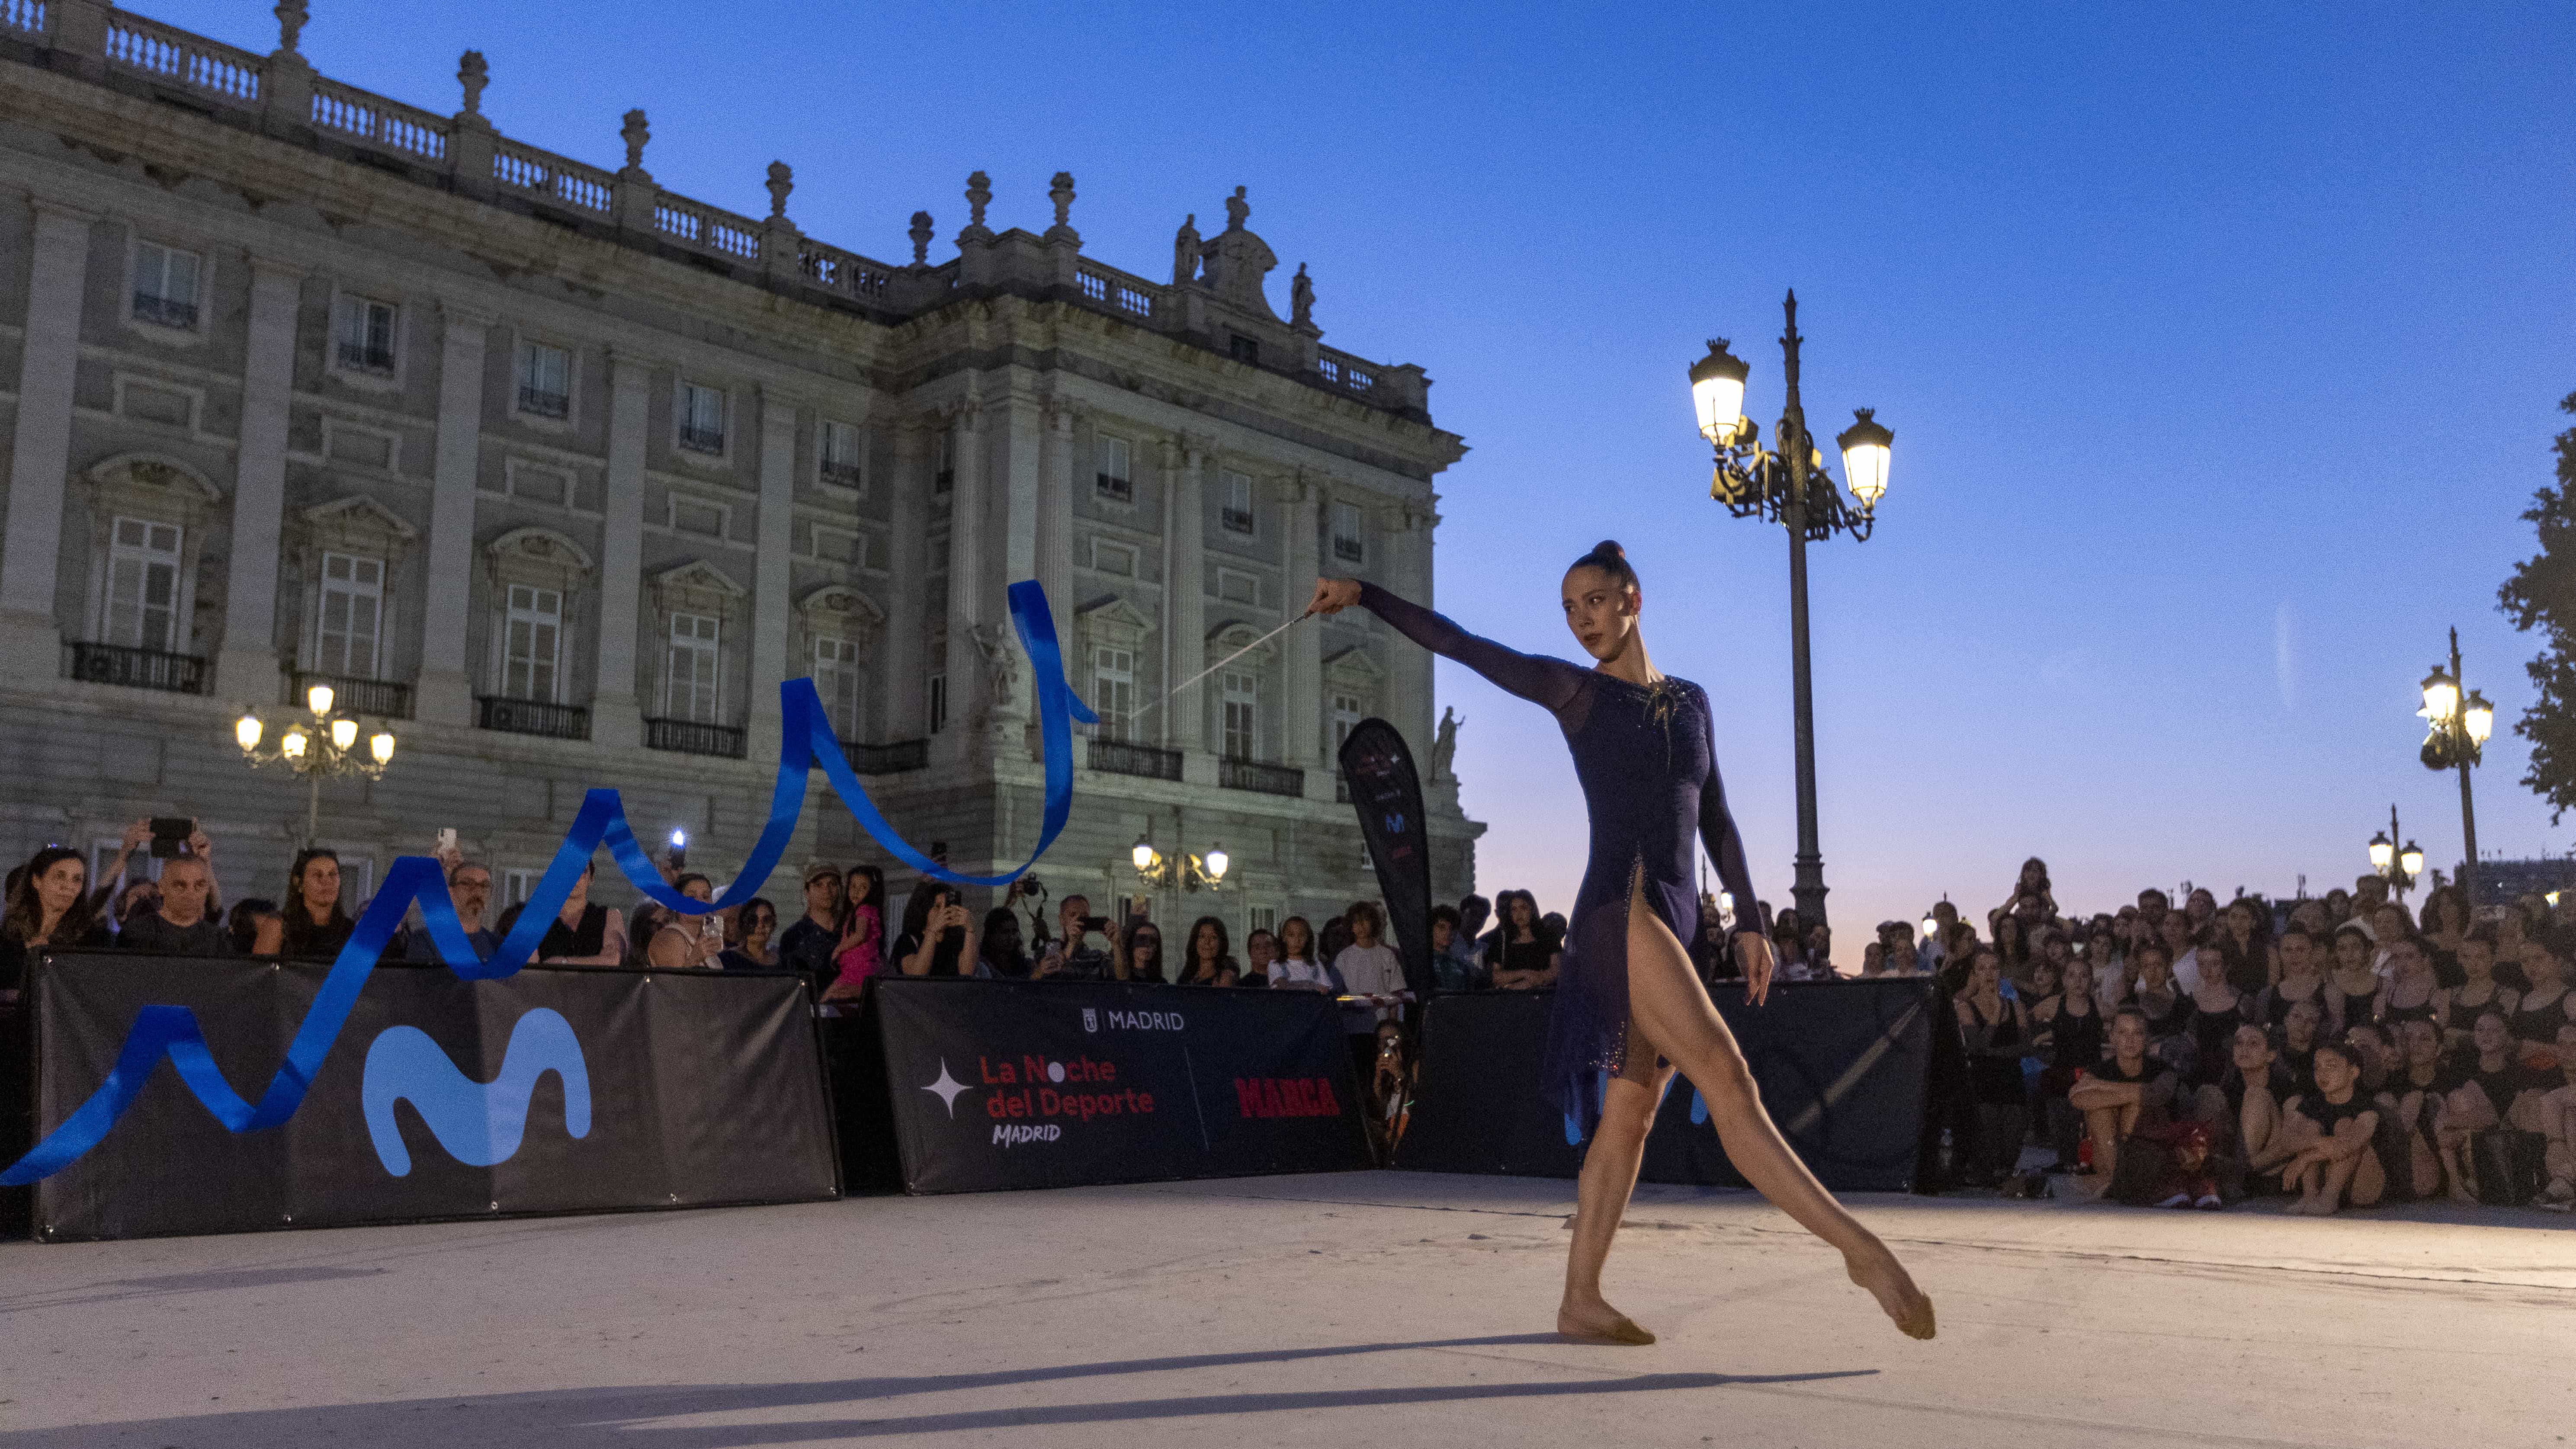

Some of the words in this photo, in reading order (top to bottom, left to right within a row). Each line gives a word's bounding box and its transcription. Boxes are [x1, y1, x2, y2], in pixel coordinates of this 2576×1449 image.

[1108, 1010, 1184, 1031] MADRID
[980, 1055, 1016, 1084] La
[1024, 1054, 1116, 1083] Noche
[986, 1087, 1033, 1118] del
[1039, 1087, 1155, 1122] Deporte
[1234, 1076, 1340, 1118] MARCA
[992, 1124, 1061, 1148] MADRID
